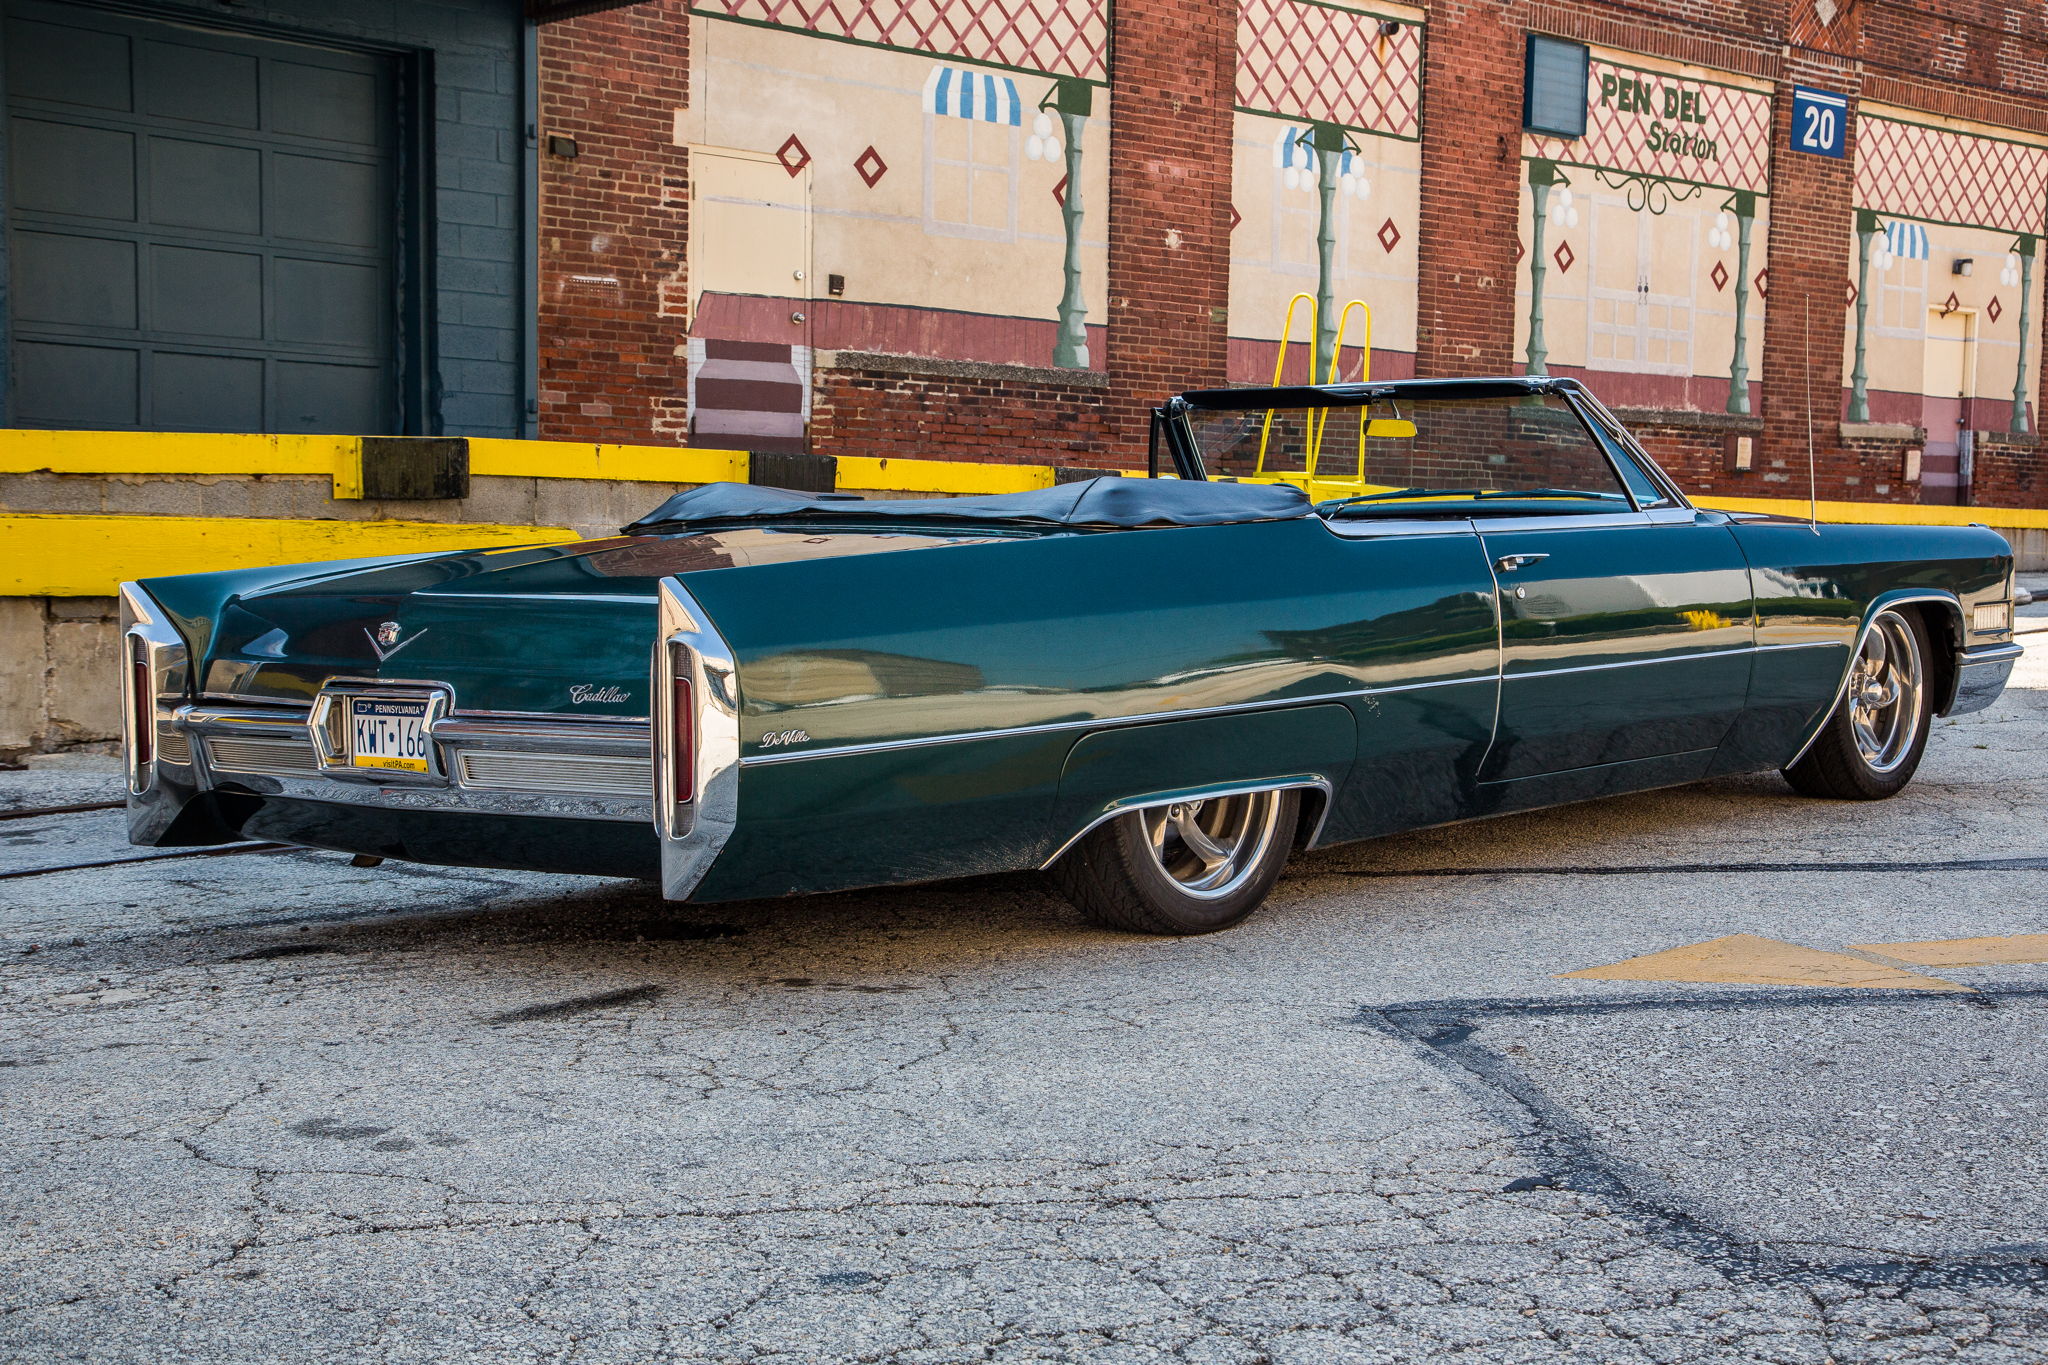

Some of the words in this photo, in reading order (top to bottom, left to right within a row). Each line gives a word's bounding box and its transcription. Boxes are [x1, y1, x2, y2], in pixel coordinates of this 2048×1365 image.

[1601, 73, 1651, 116] PEN
[1664, 86, 1707, 125] DEL
[1645, 120, 1718, 162] Station
[1802, 105, 1835, 150] 20
[375, 704, 420, 715] PENNSYLVANIA
[569, 683, 632, 705] Cadillac
[382, 760, 416, 770] visitPA.com
